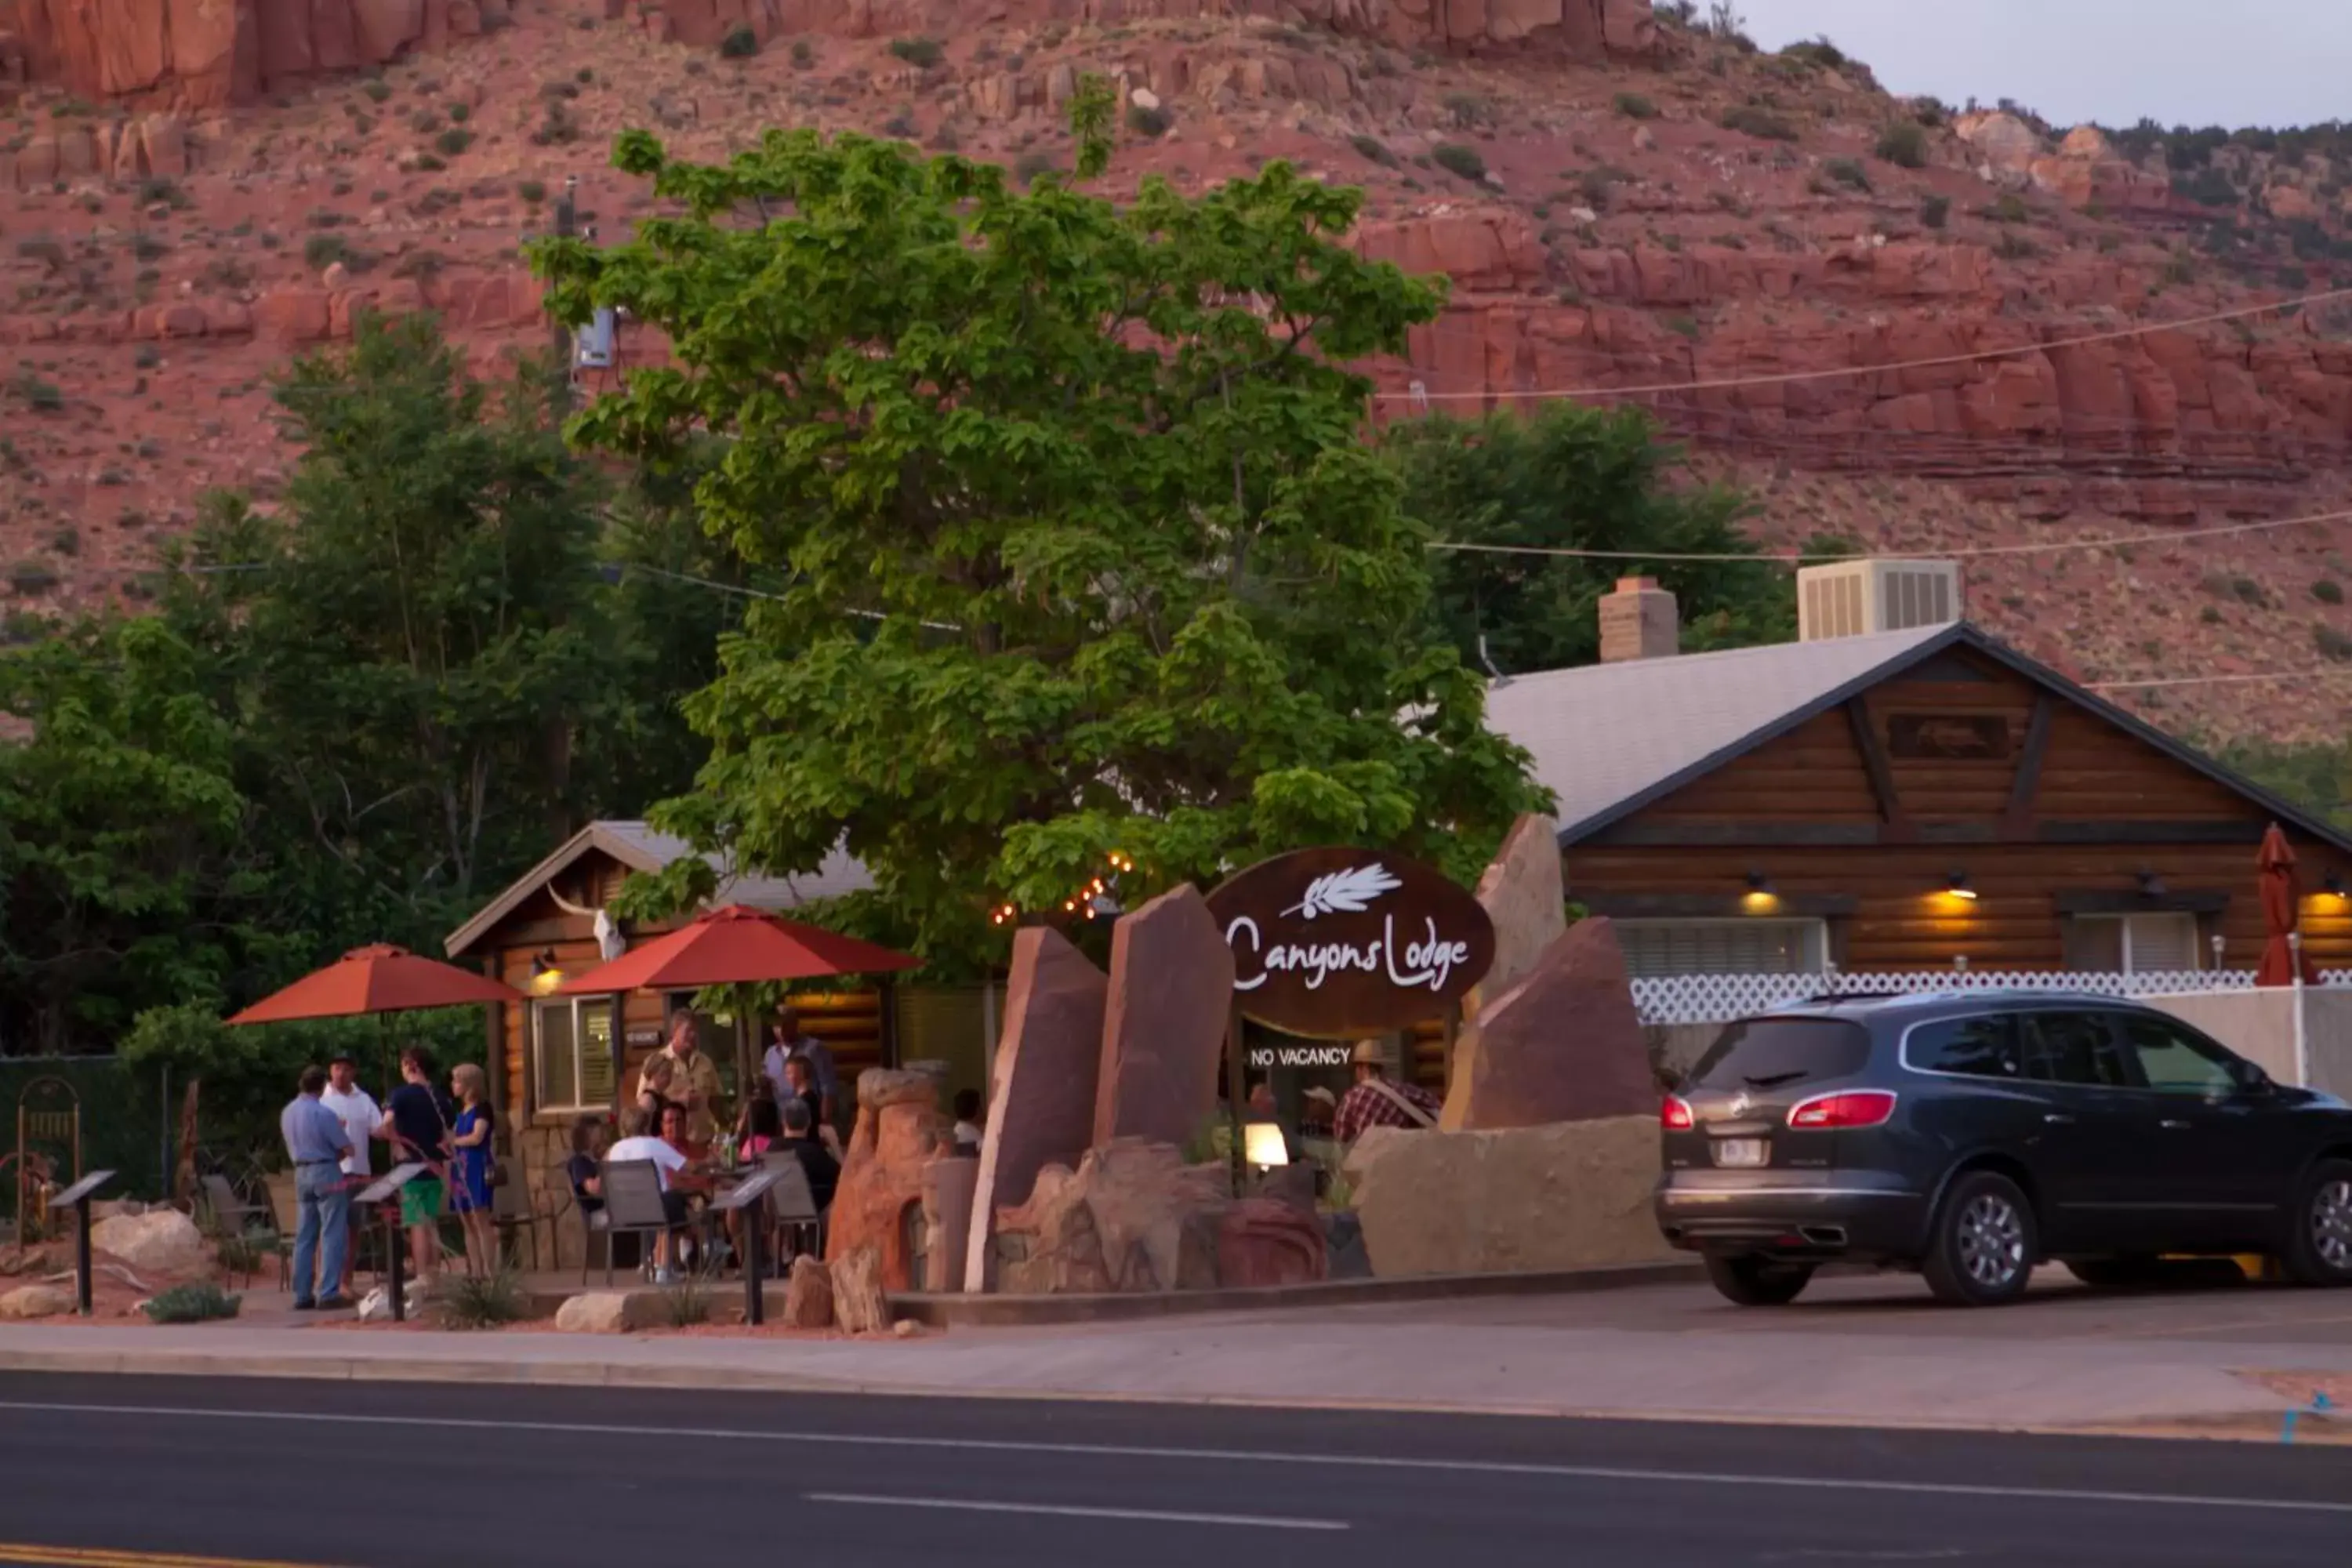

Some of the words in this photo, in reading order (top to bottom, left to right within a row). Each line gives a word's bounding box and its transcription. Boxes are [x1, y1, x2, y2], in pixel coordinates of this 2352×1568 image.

[1225, 916, 1382, 990] Canyons
[1385, 913, 1469, 991] Lodge
[1250, 1050, 1274, 1066] NO
[1278, 1047, 1351, 1065] VACANCY
